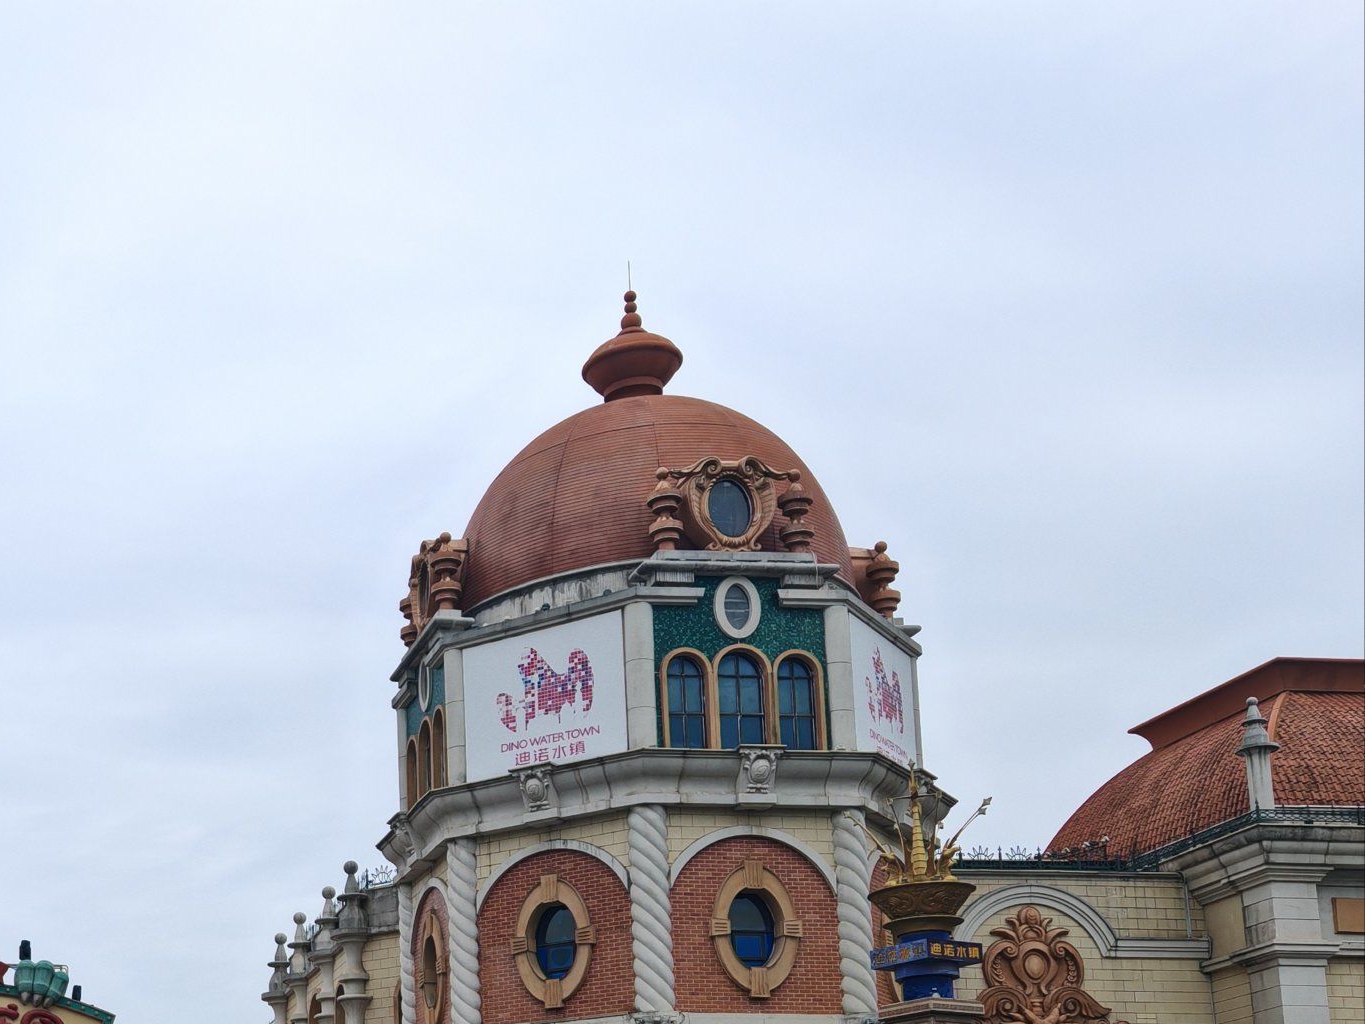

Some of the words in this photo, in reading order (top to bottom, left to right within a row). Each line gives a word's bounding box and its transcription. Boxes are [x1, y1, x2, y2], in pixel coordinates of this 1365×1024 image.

[500, 739, 529, 753] DINO
[529, 731, 565, 747] WATER
[565, 725, 601, 740] TOWN
[515, 740, 586, 767] 迪诺水镇
